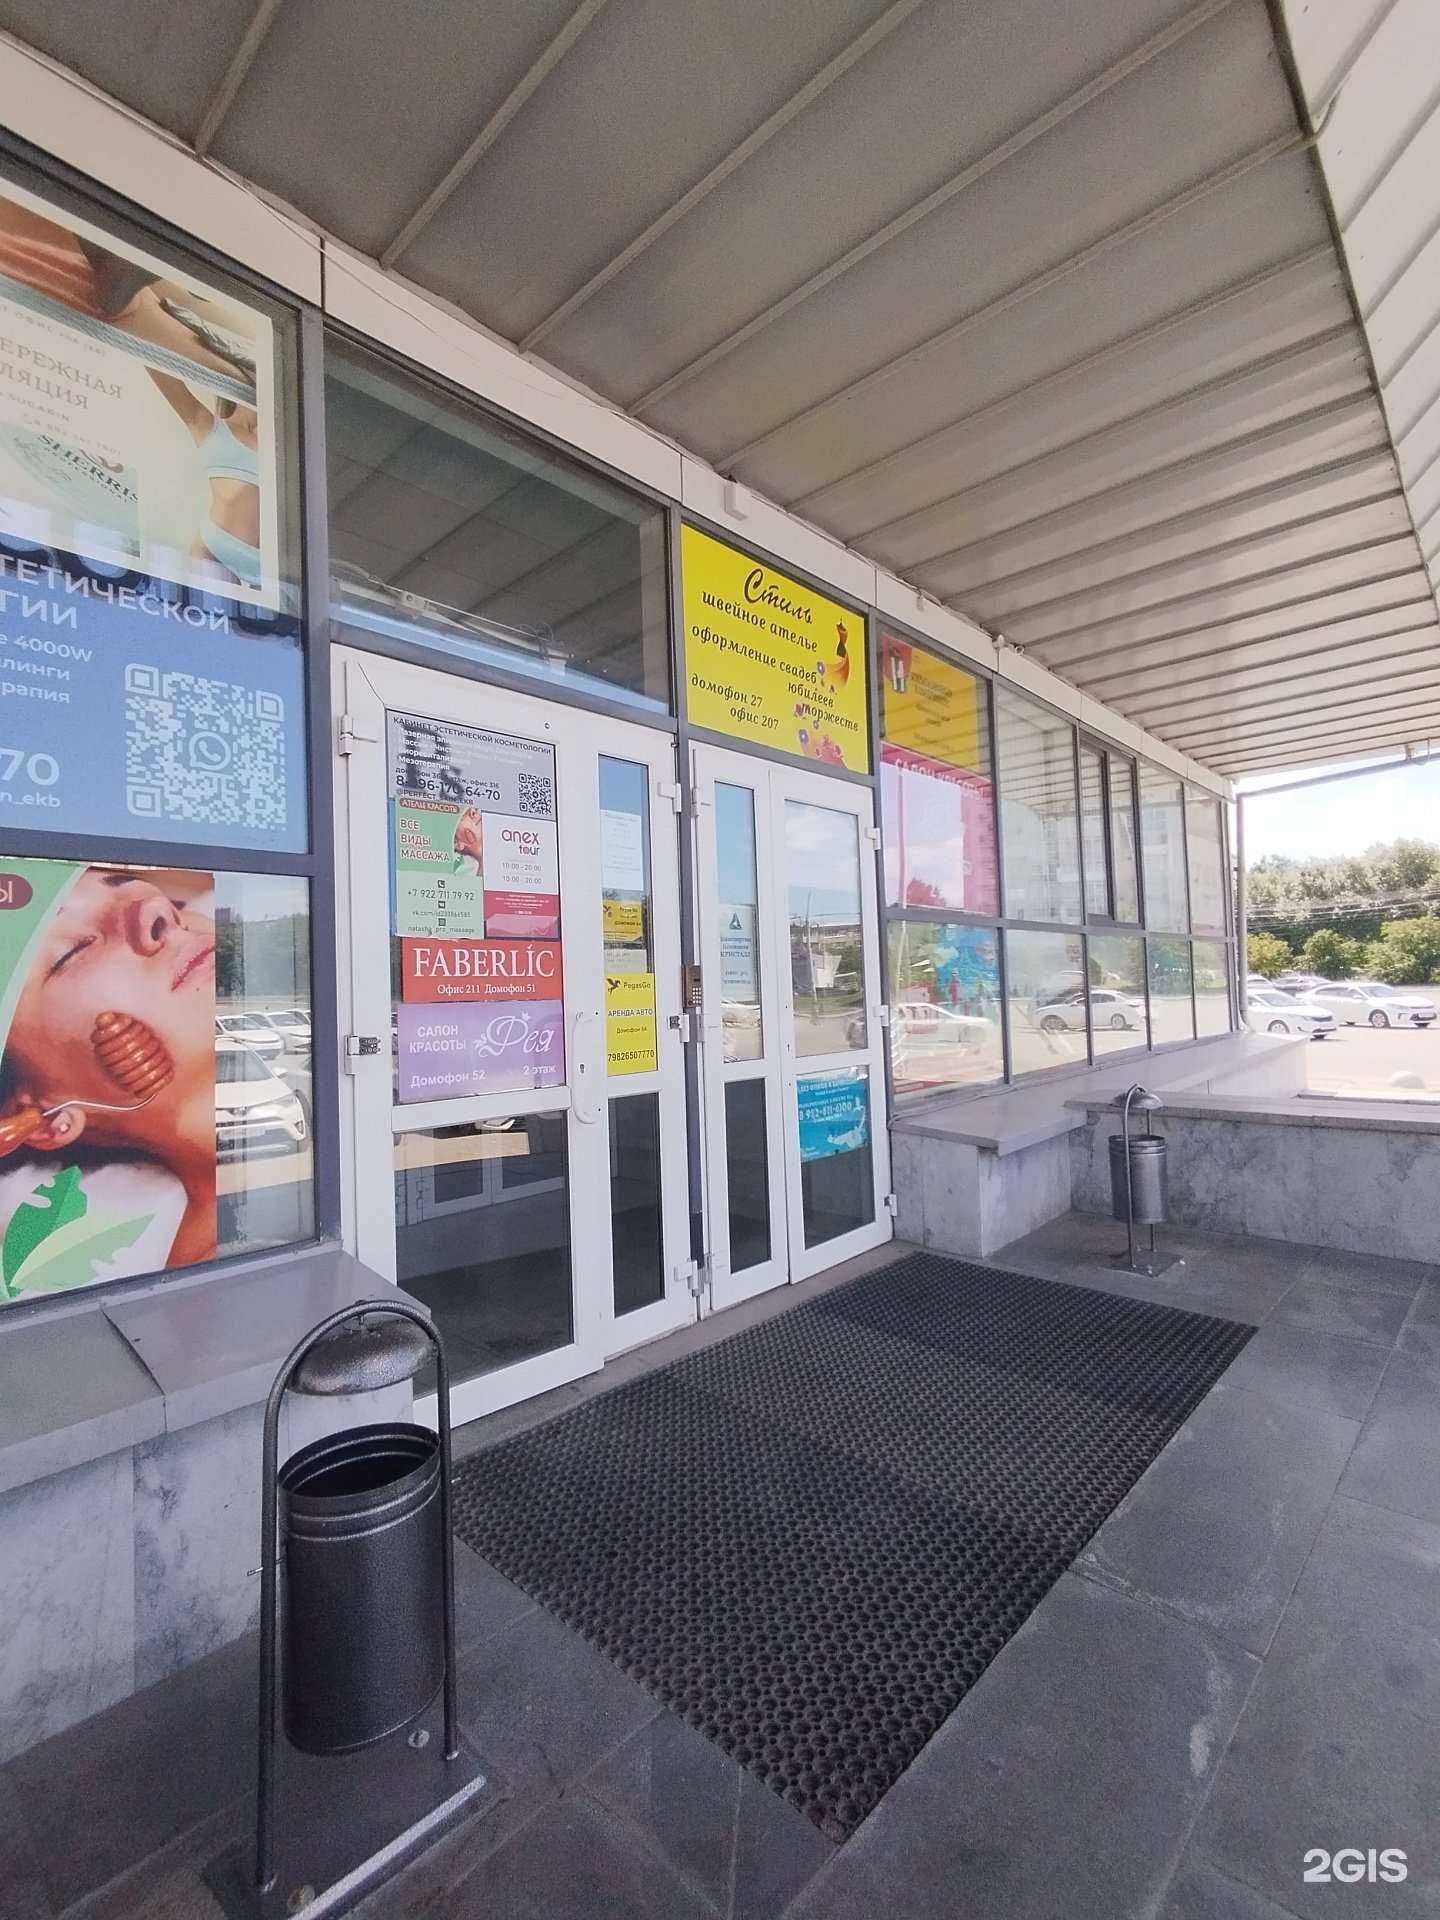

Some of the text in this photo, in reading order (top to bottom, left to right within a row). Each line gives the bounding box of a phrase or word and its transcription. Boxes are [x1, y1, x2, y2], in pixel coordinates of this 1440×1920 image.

[744, 568, 813, 625] Стиль
[702, 591, 818, 652] швейное ателье
[13, 635, 93, 663] 4000W
[692, 625, 817, 684] оформление свадеб
[691, 673, 763, 708] домофон 27
[788, 682, 834, 708] юбилеев
[730, 707, 779, 730] офис 207
[800, 703, 859, 732] торжеств
[393, 716, 432, 731] КАБИНЕТ
[433, 725, 493, 744] ЭСТЕТИЧЕСКОЙ
[400, 819, 420, 830] ВСЕ
[400, 834, 431, 846] ВИДЫ
[501, 829, 540, 845] anex
[401, 850, 450, 862] МАССАЖА
[519, 847, 540, 857] tour
[420, 889, 436, 899] 922
[464, 892, 475, 901] 92
[437, 983, 536, 996] Офис 211 Домофон 51
[607, 1008, 654, 1018] АРЕНДА АВТО
[417, 1024, 459, 1038] САЛОН
[409, 1039, 467, 1054] КРАСОТЫ
[523, 1063, 557, 1075] 2 этаж
[410, 1069, 487, 1089] Домофон 52
